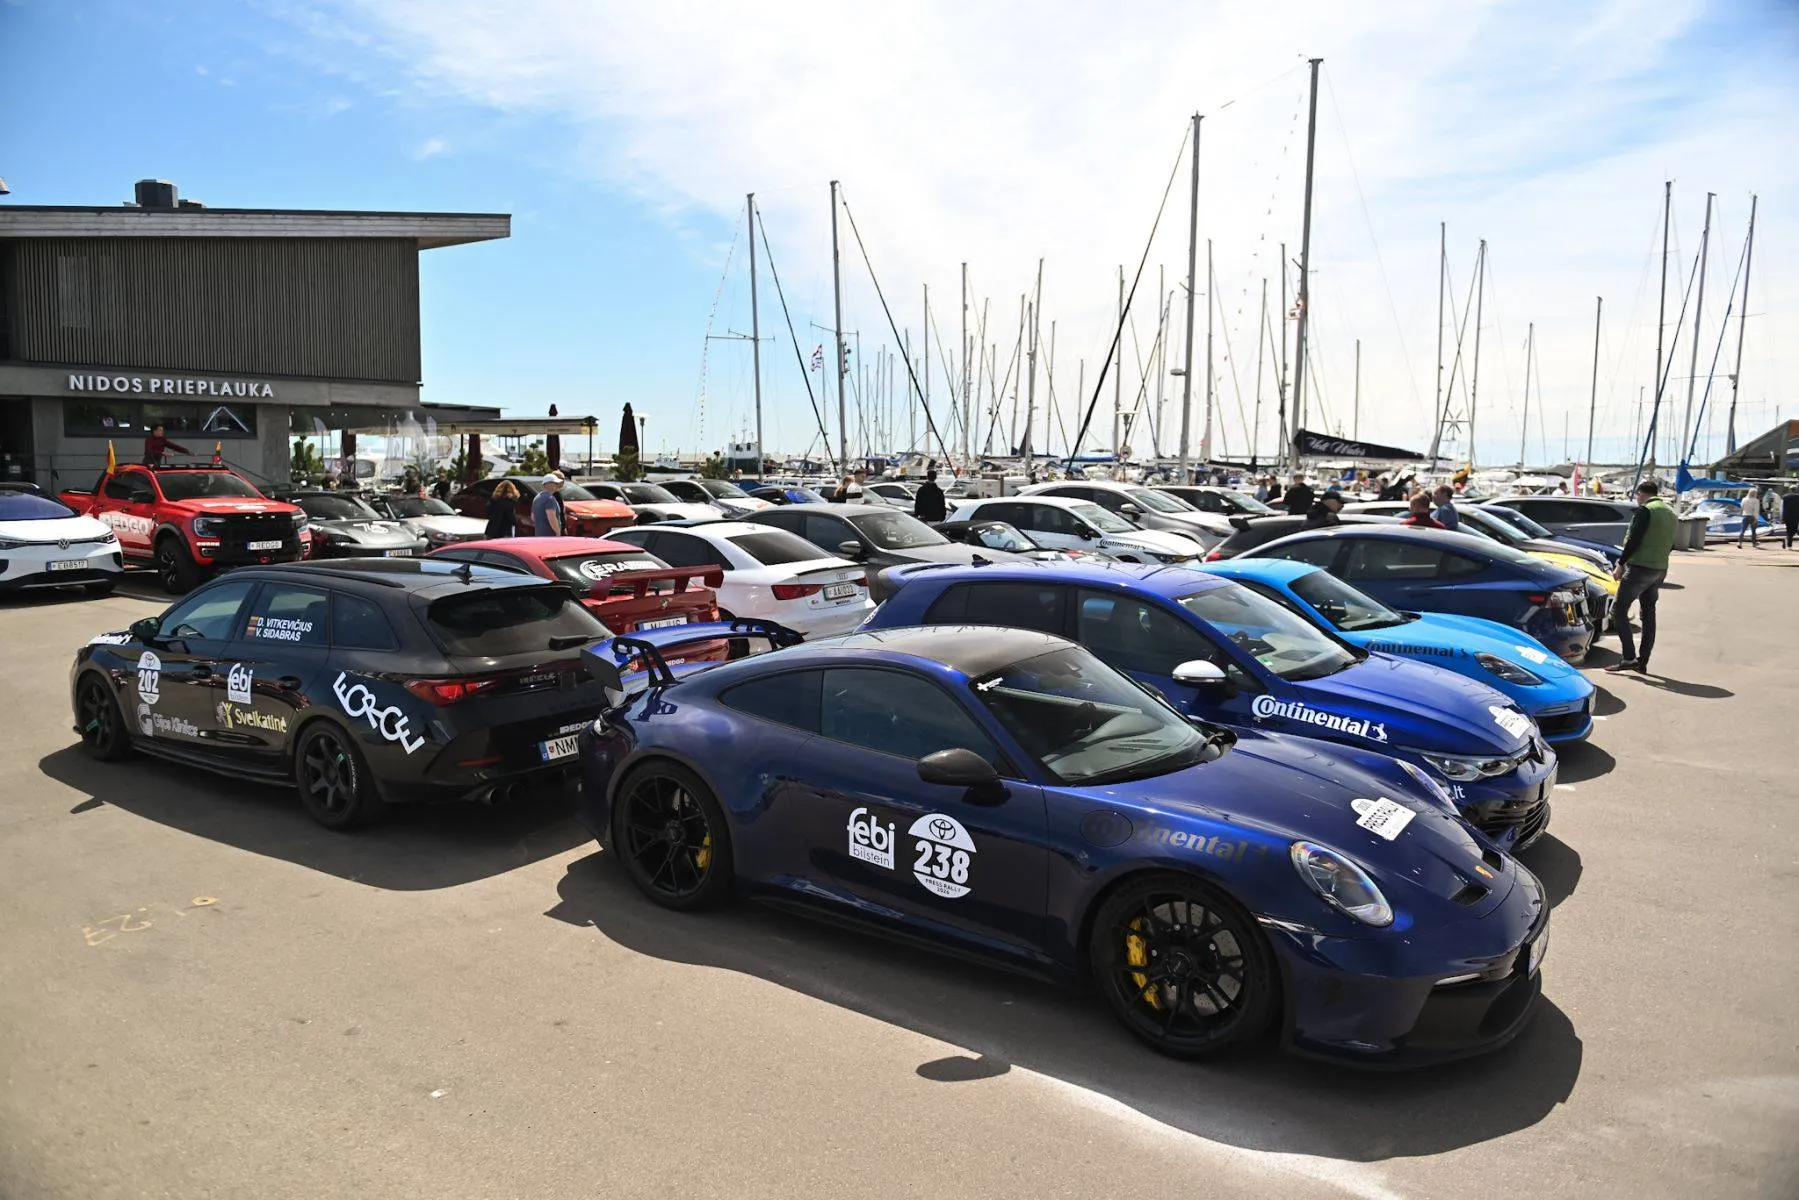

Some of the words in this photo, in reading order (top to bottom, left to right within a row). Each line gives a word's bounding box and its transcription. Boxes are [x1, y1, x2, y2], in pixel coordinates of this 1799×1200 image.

[68, 374, 143, 393] NIDOS
[151, 378, 274, 398] PRIEPLAUKA
[1100, 538, 1140, 551] Continental
[255, 627, 262, 638] V.
[262, 628, 302, 642] SIDABRAS
[257, 617, 264, 627] D.
[266, 618, 313, 633] VITKEVIČIUS
[138, 669, 159, 693] 202
[1251, 694, 1371, 738] Continental
[846, 807, 896, 855] febi
[852, 846, 890, 867] bilstein
[913, 840, 971, 884] 238
